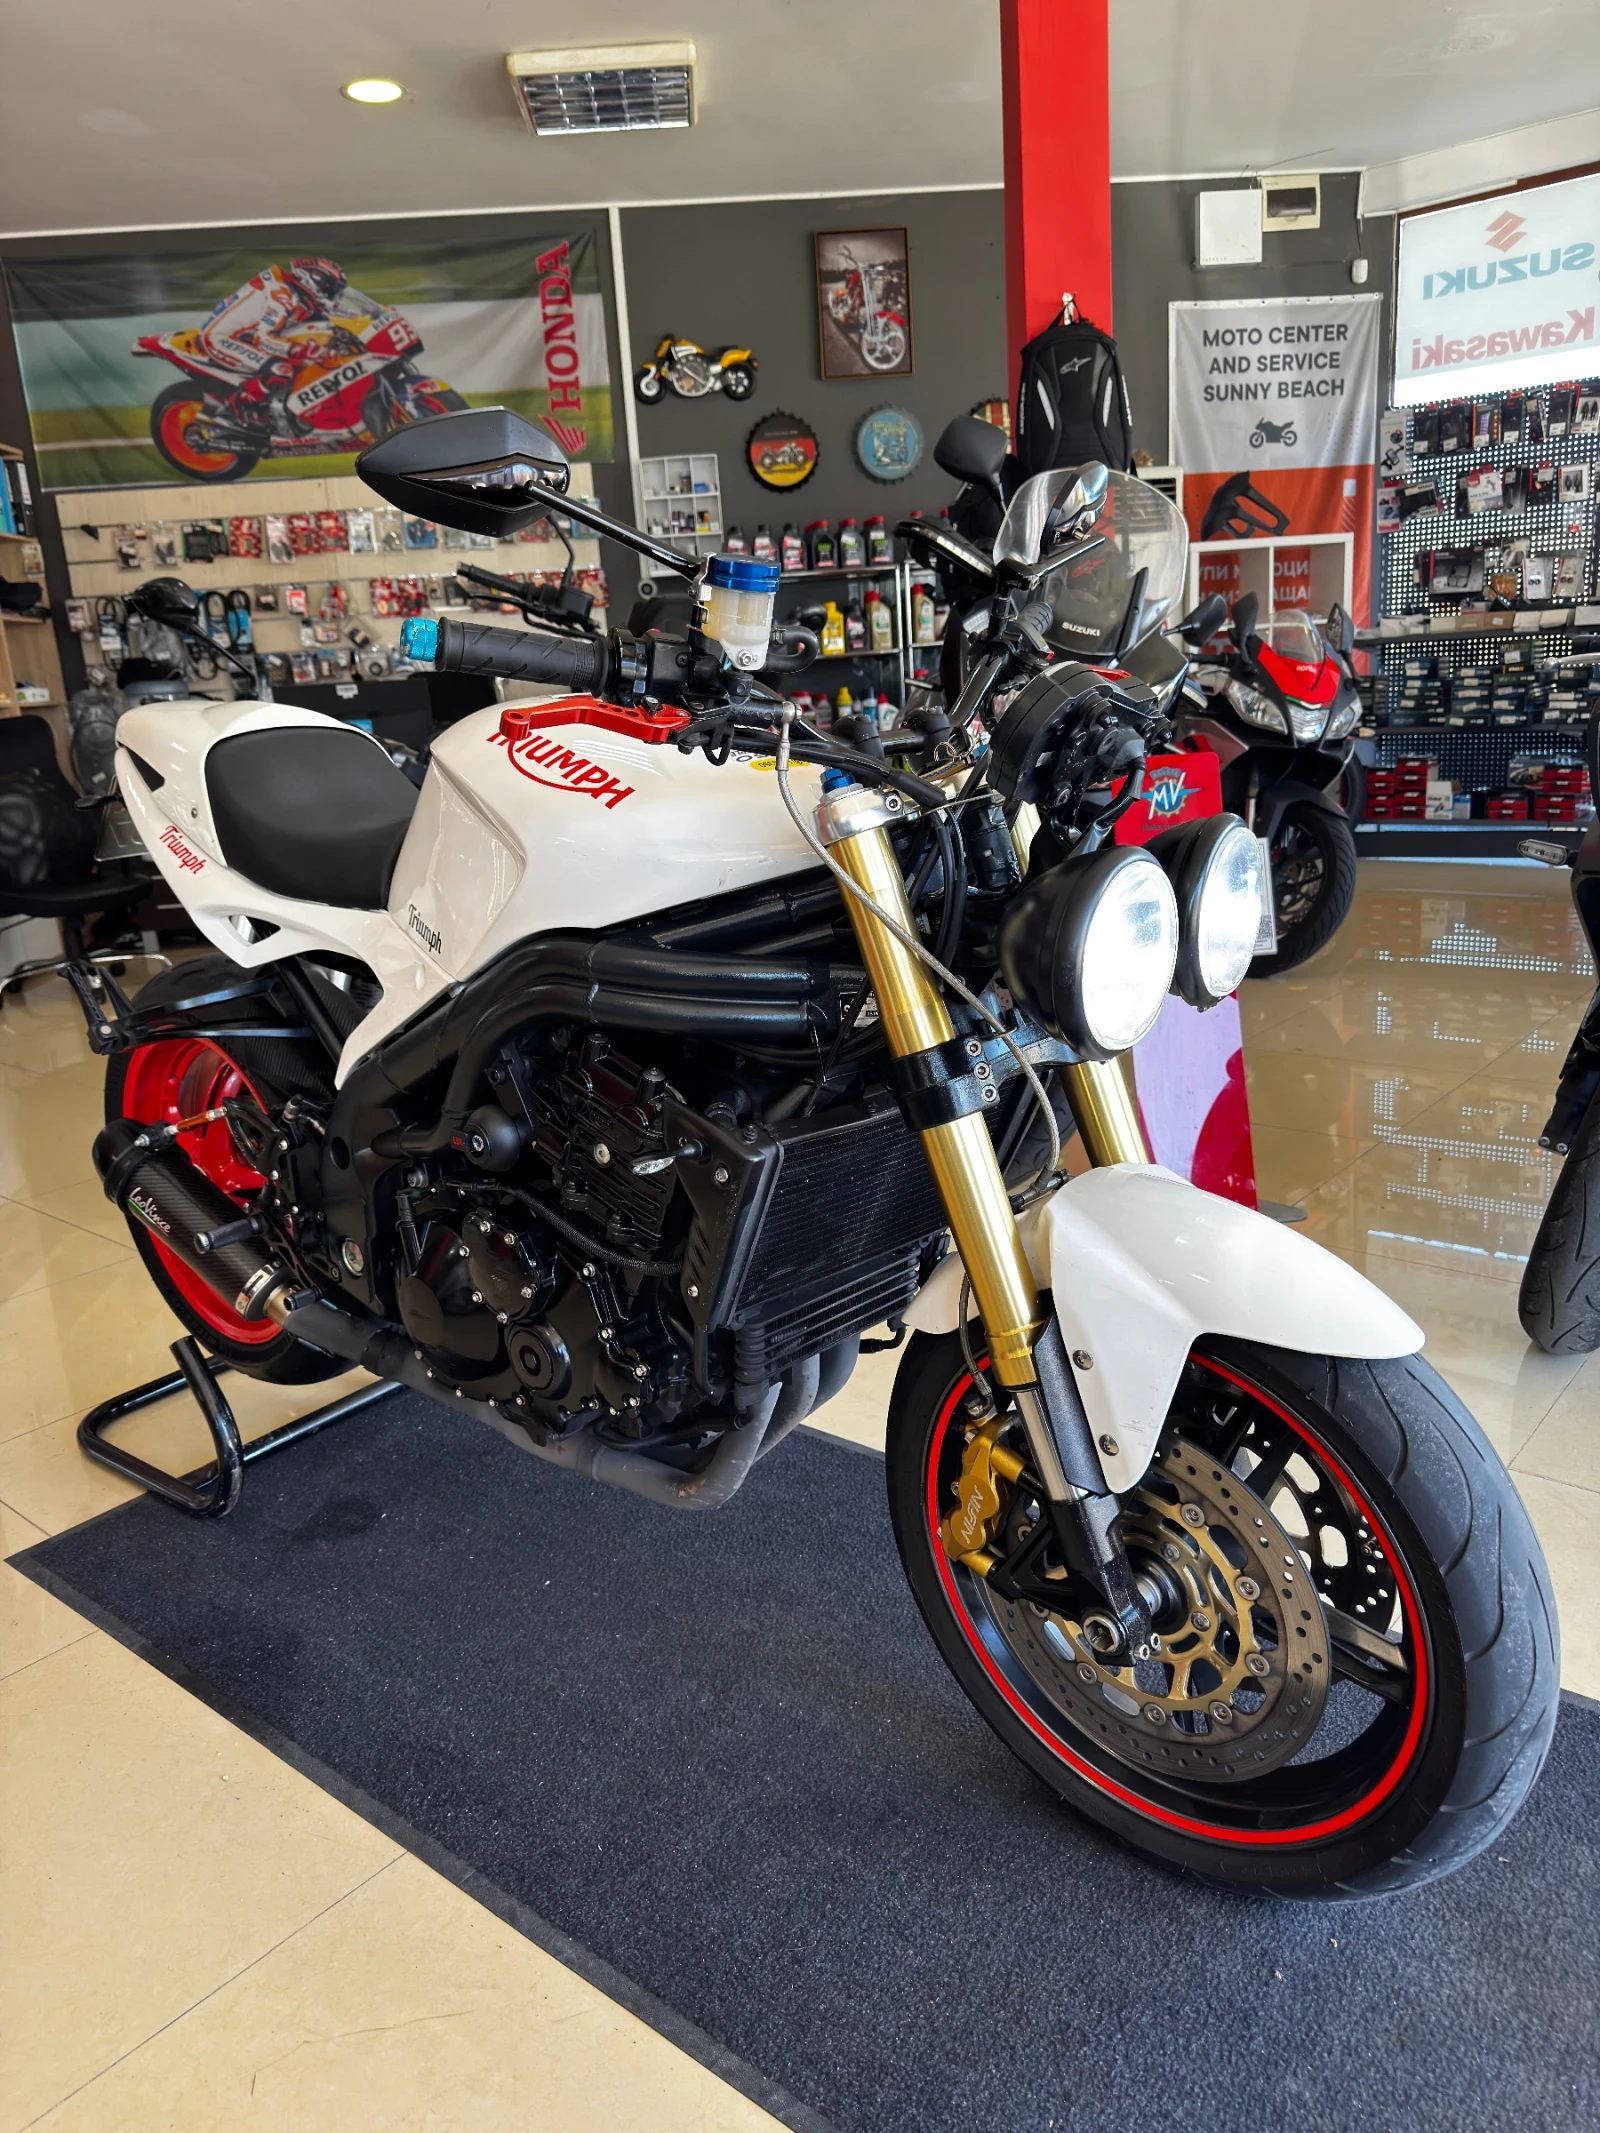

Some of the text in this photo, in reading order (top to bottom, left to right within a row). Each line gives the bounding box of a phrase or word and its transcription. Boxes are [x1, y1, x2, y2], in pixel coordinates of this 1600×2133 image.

[536, 240, 583, 413] HONDA
[1203, 323, 1349, 347] MOTO CENTER
[1208, 351, 1341, 375] AND SERVICE
[1203, 378, 1345, 402] SUNNY BEACH
[1061, 621, 1100, 637] SUZUKI
[1148, 771, 1187, 820] MV
[159, 825, 207, 875] Triumph
[408, 903, 442, 955] Triumph
[129, 1186, 171, 1233] LeoVince
